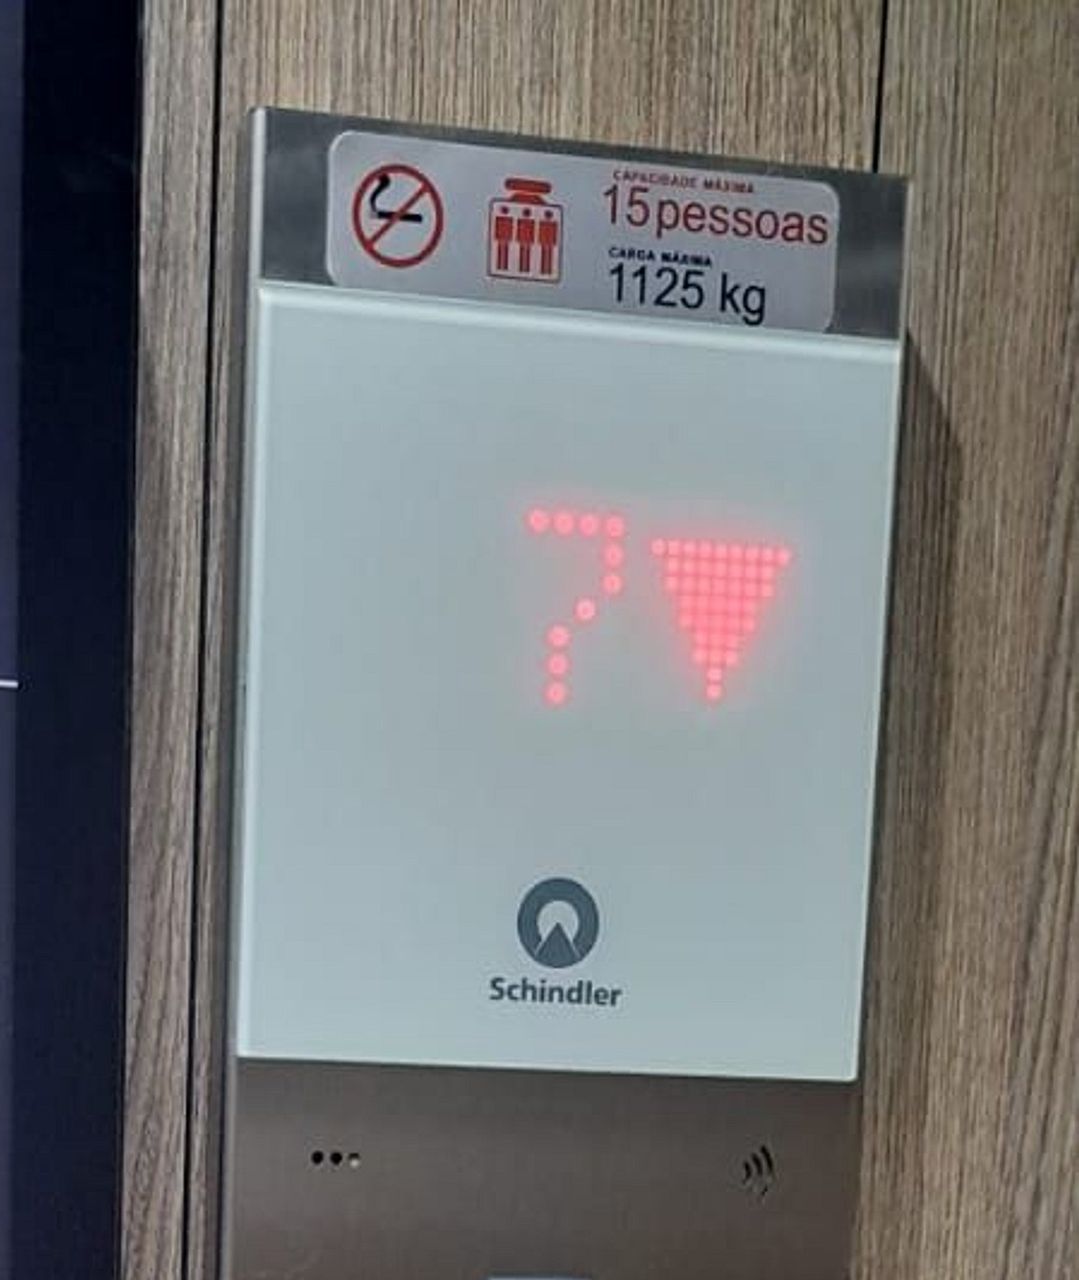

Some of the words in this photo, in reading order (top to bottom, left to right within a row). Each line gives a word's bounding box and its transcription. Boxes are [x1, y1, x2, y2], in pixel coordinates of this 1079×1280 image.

[609, 262, 706, 310] 1125
[720, 272, 767, 327] kg
[527, 509, 625, 706] 7
[488, 976, 622, 1008] Schindler
